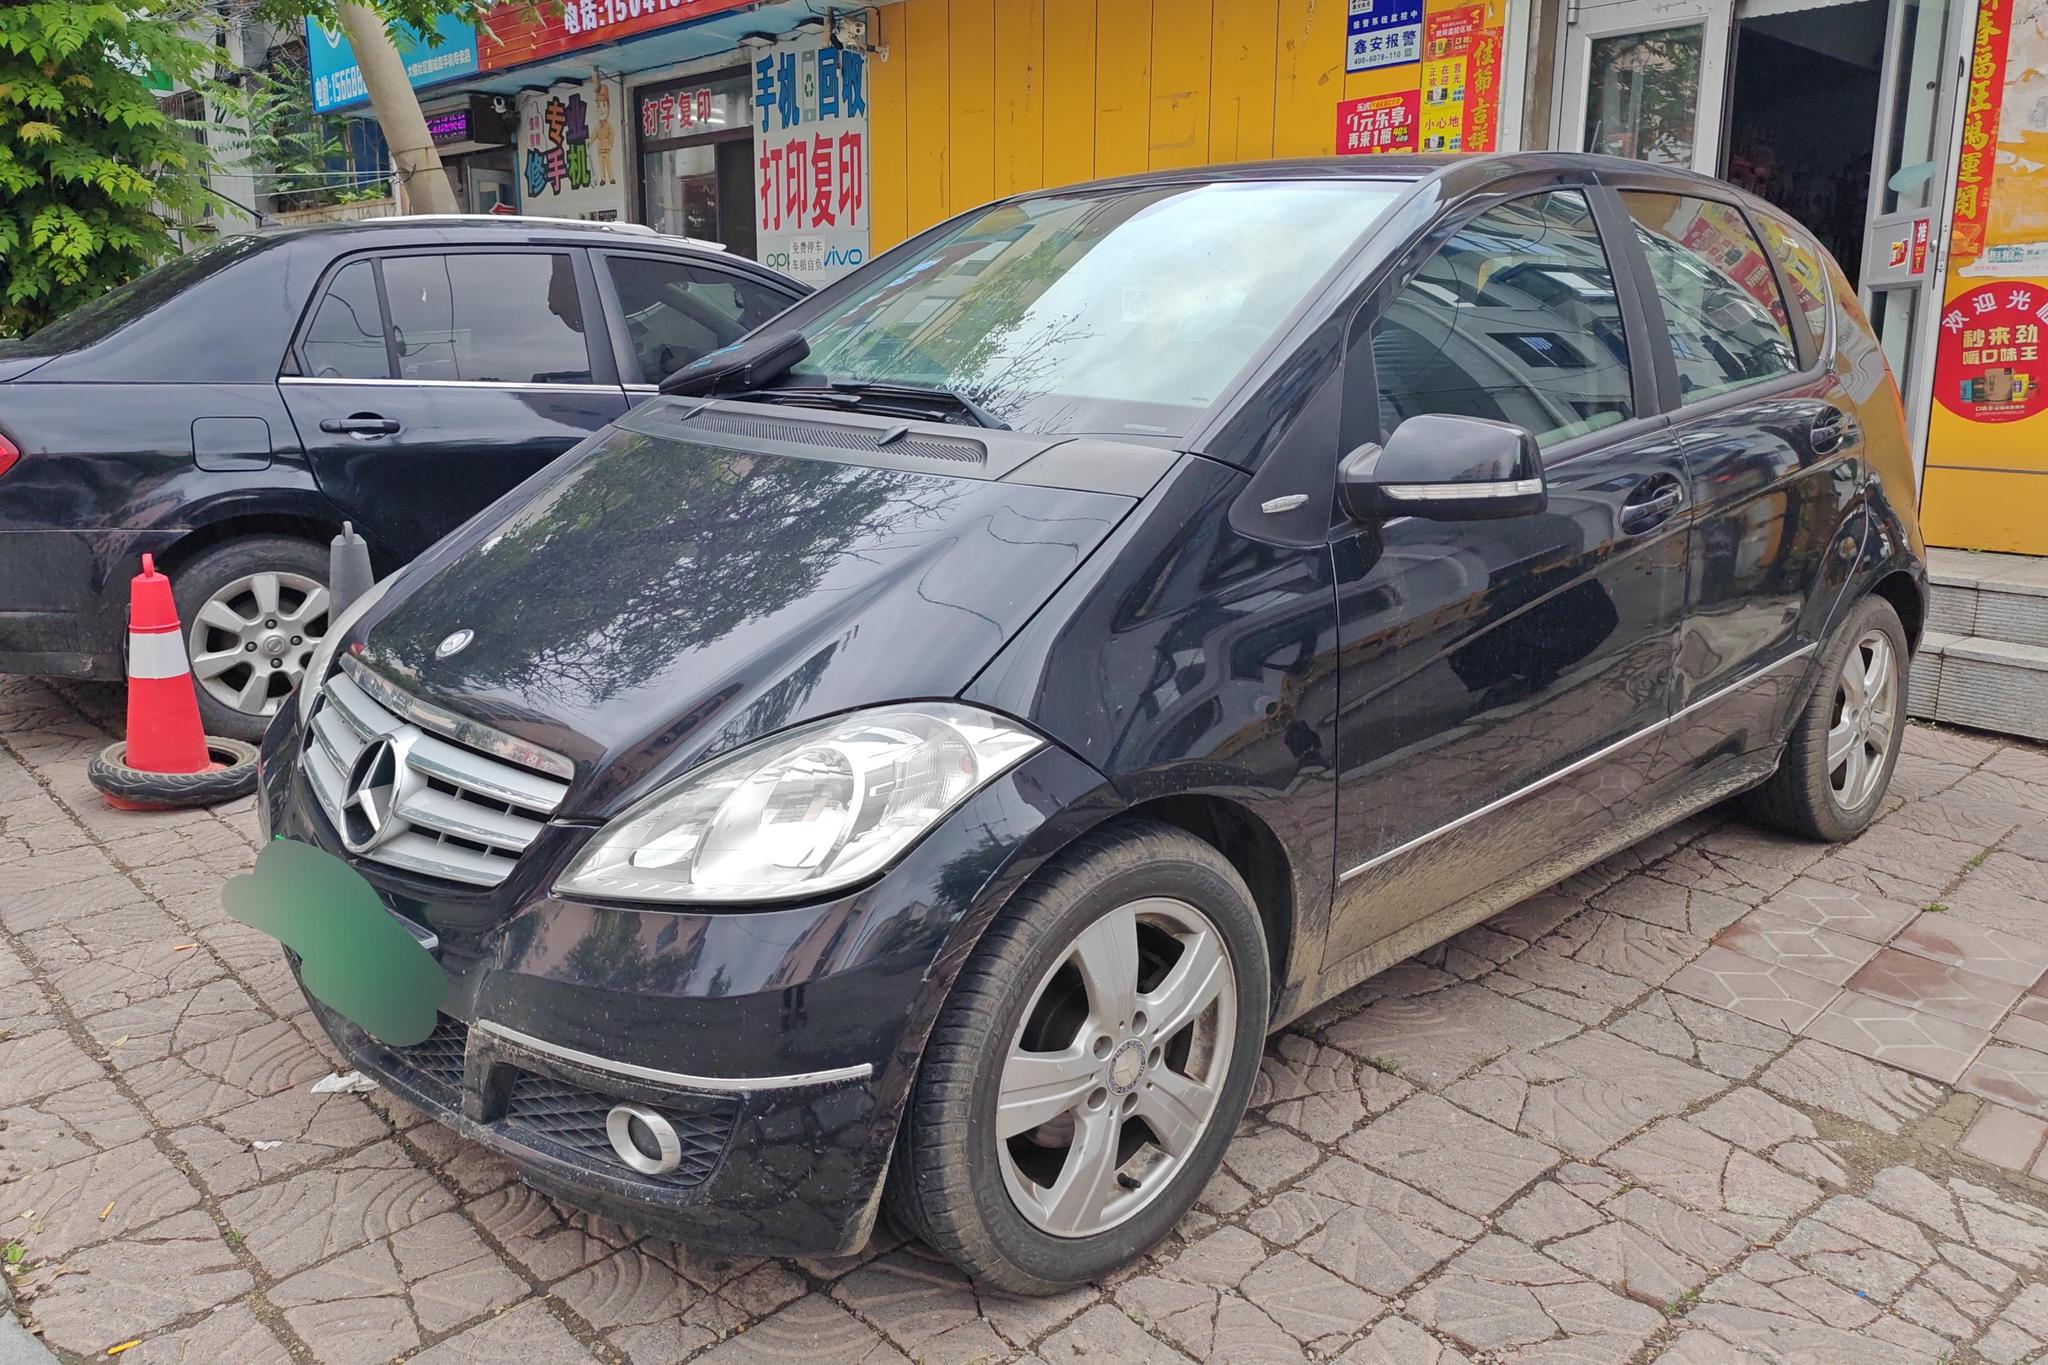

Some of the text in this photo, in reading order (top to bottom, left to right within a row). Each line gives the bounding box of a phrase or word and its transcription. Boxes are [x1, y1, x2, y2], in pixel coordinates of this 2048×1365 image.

[1353, 30, 1417, 55] 鑫安报警
[1353, 51, 1402, 65] 400-6078-110
[545, 93, 589, 146] 专业
[643, 88, 713, 136] 打字复印
[524, 144, 591, 197] 修手机
[759, 130, 862, 231] 打印复印
[792, 240, 823, 255] 免费停车
[792, 258, 823, 272] 车损自负
[1963, 324, 2039, 349] 秒来劲
